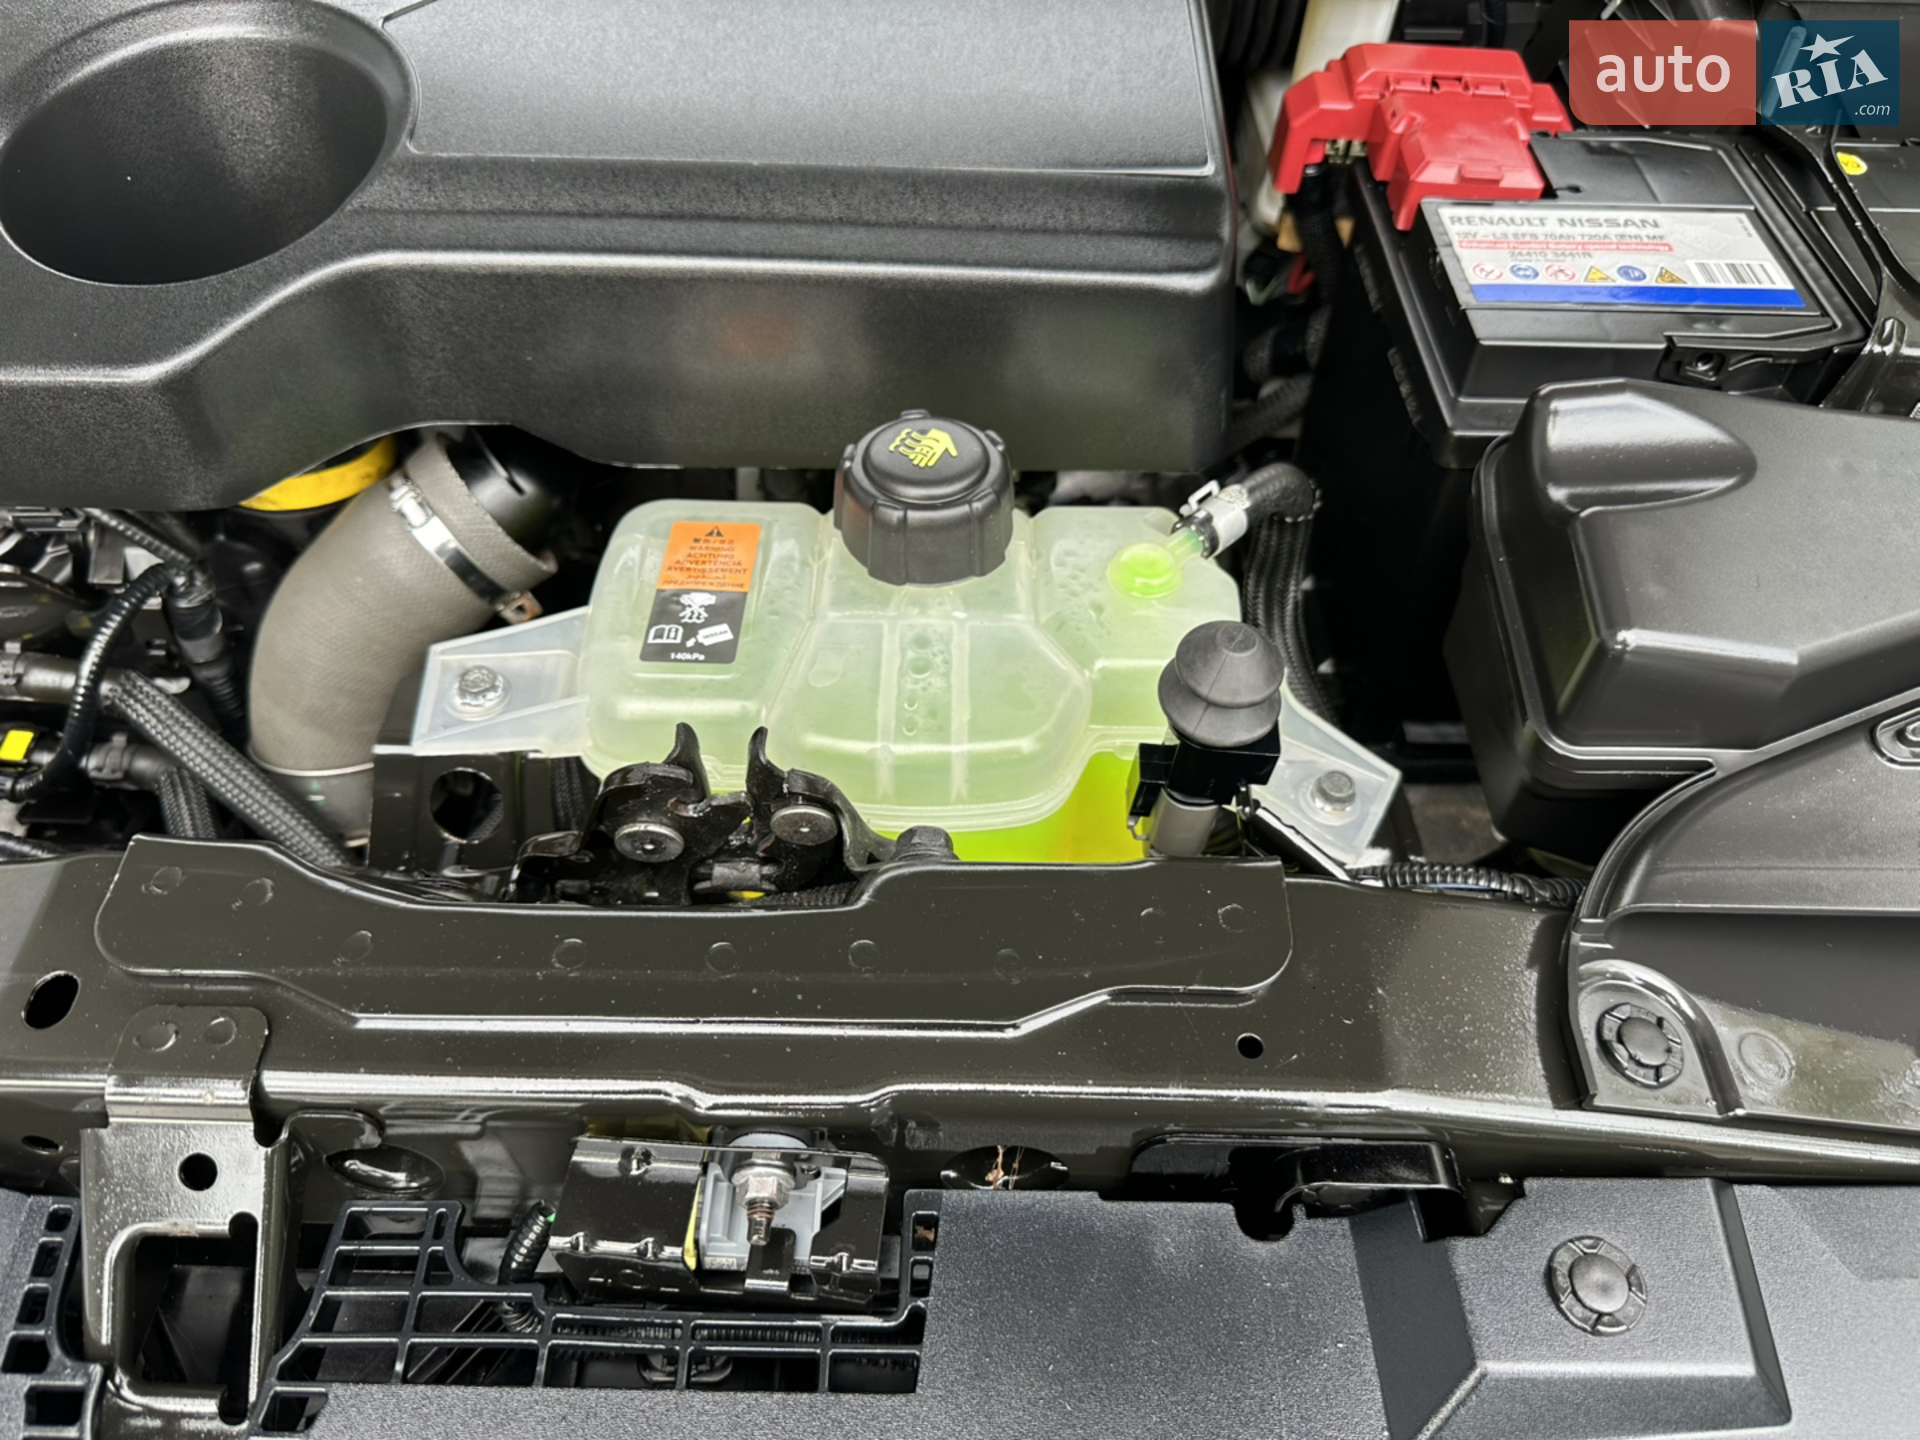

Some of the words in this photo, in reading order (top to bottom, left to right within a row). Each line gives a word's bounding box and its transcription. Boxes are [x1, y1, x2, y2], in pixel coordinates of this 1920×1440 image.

[1448, 215, 1548, 227] RENAULT
[1557, 217, 1661, 229] NISSAN
[1578, 232, 1611, 242] 720A
[686, 552, 735, 560] ACHTUNG
[666, 566, 748, 575] AVERTISSEMENT
[662, 580, 745, 588] ПРЕДУПРЕЖДЕНИЕ
[670, 652, 706, 661] 140kPa
